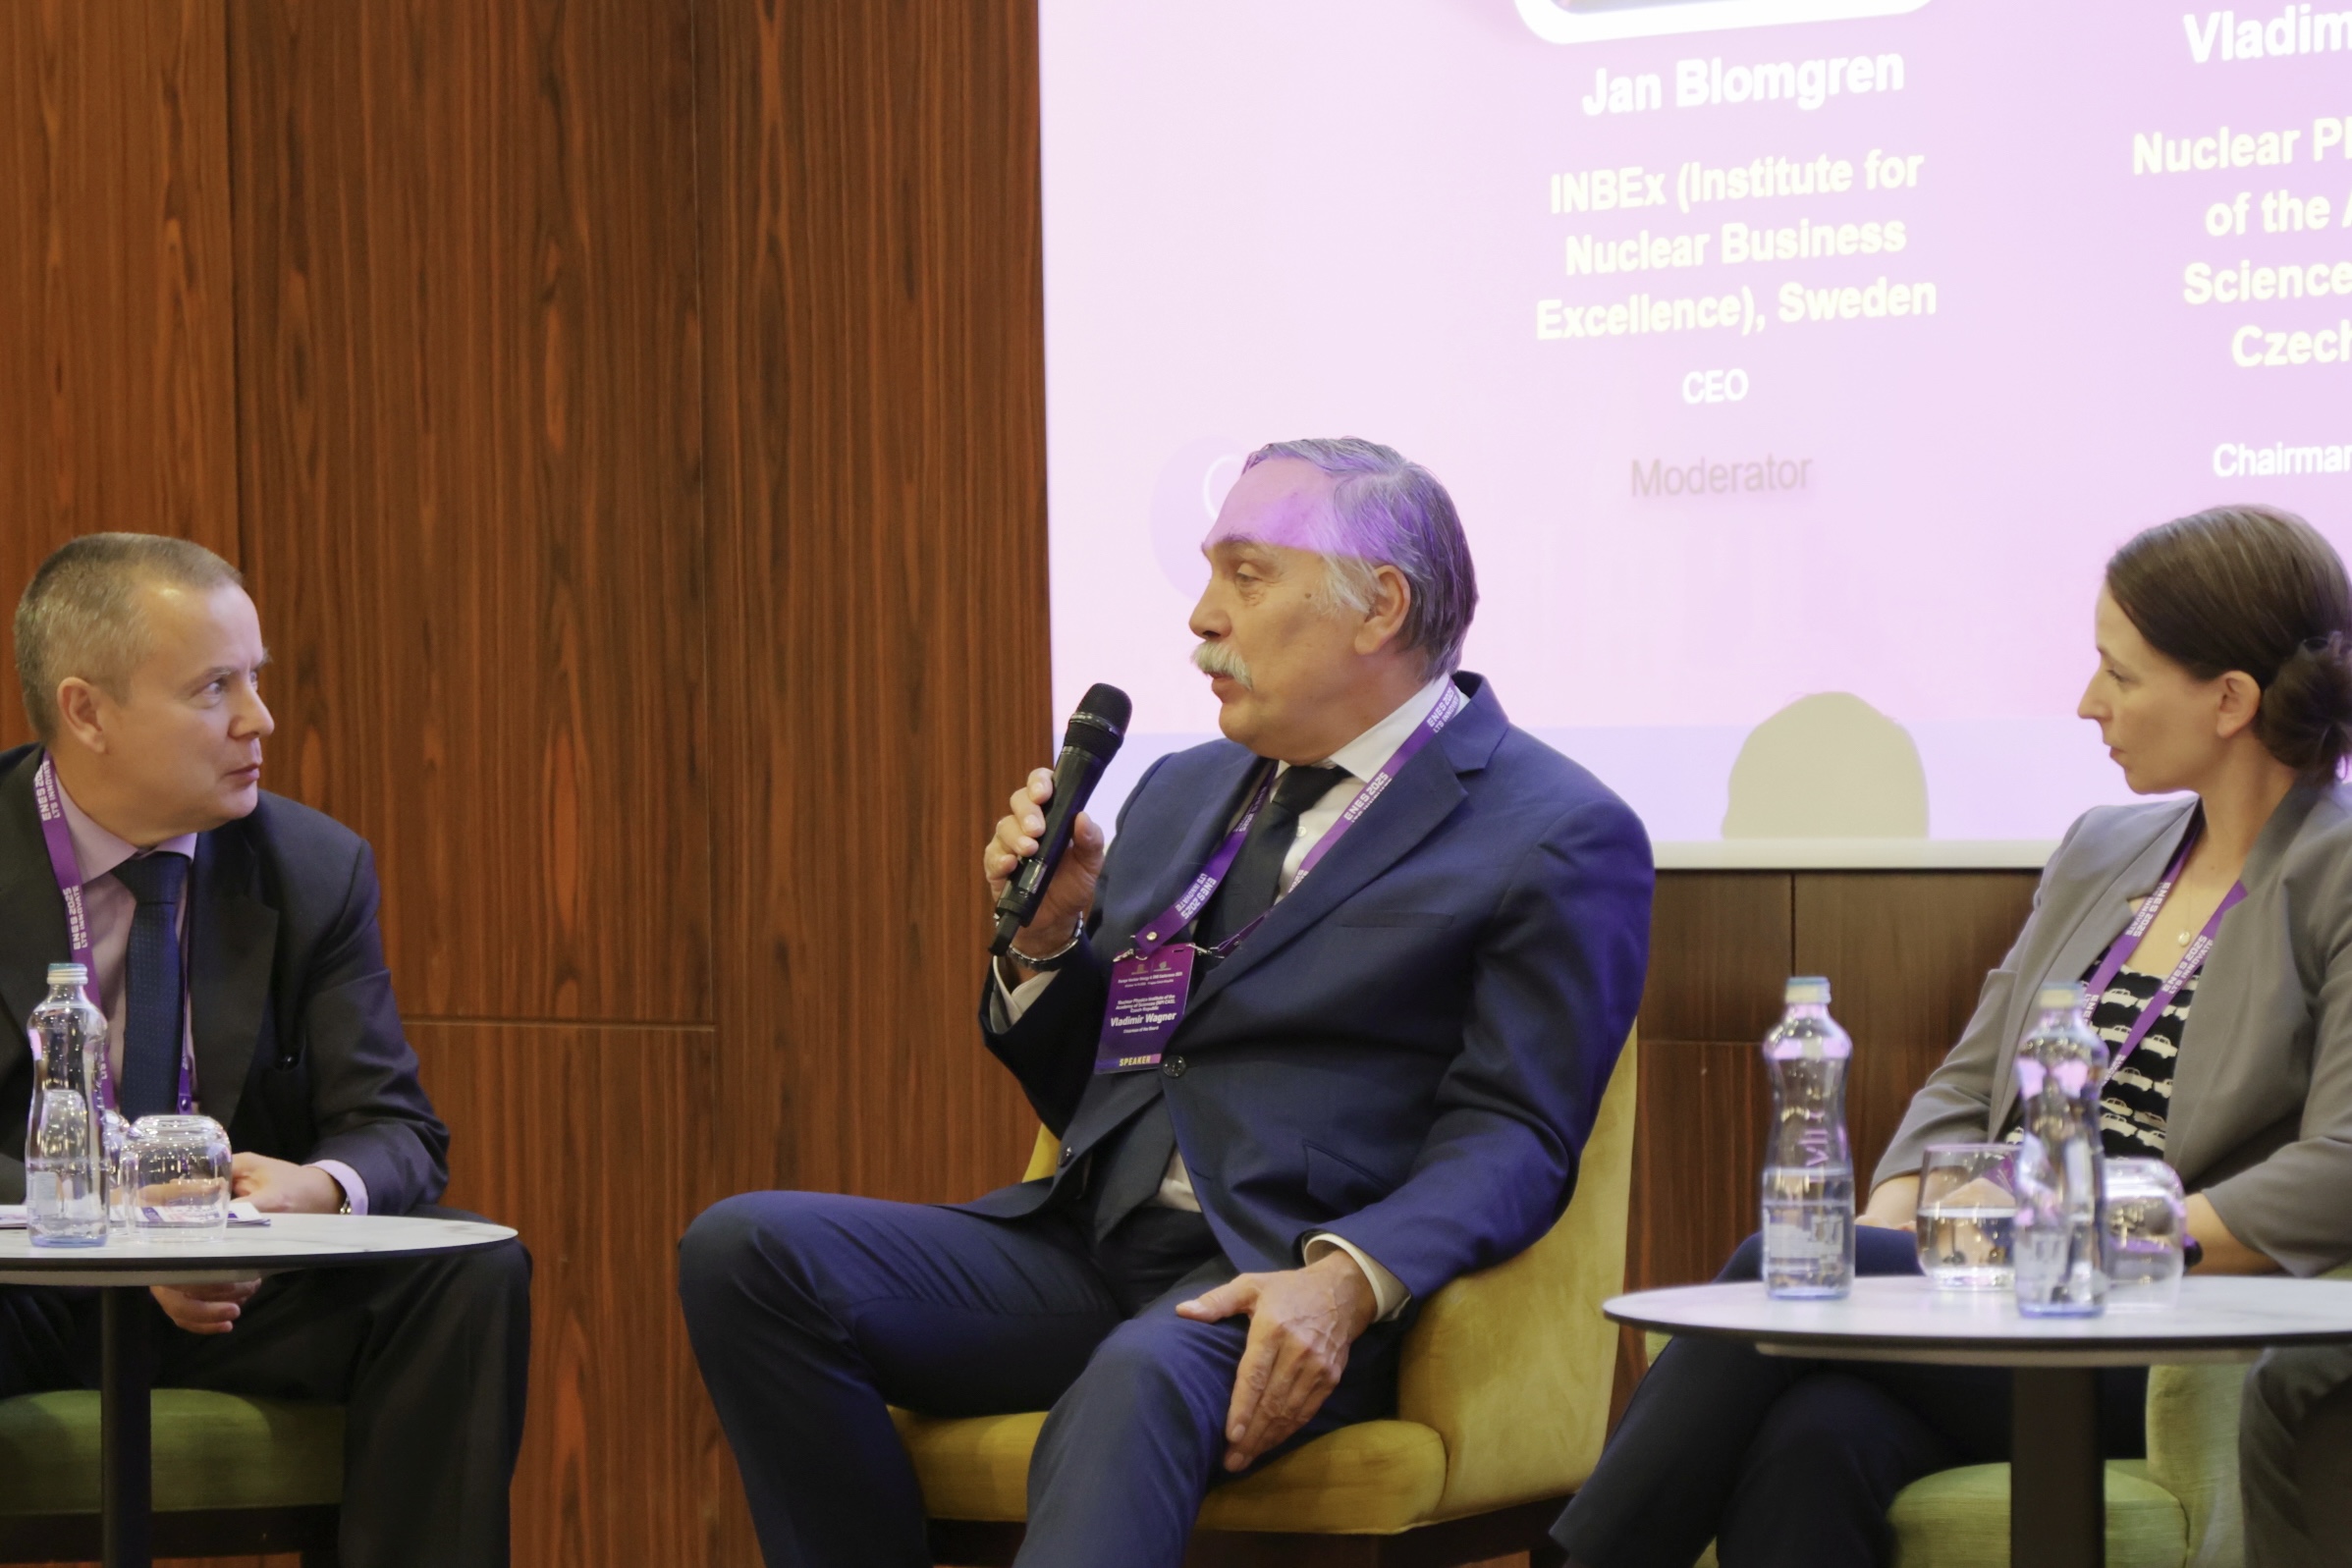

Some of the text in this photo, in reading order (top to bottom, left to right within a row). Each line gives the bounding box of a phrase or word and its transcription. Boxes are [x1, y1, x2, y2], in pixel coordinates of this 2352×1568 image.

[1582, 53, 1904, 116] Jan Blomgren
[2134, 126, 2301, 176] Nuclear
[1550, 148, 1924, 214] INBEx (Institute for
[2205, 191, 2251, 237] of
[2261, 189, 2330, 234] the
[1565, 218, 1907, 276] Nuclear Business
[2184, 259, 2352, 304] Science
[1536, 276, 1937, 340] Excellence), Sweden
[1682, 368, 1749, 405] CEO
[1631, 453, 1814, 497] Moderator
[1427, 687, 1454, 728] ENES 2025
[36, 787, 52, 822] ENES
[50, 802, 61, 819] LTS
[1343, 793, 1370, 821] ENES
[1366, 772, 1389, 796] 2025
[63, 887, 82, 950] ENES 2025
[72, 885, 85, 931] INNOVATE
[1180, 877, 1217, 920] ENES 2025
[2132, 882, 2171, 938] ENES 2025
[2161, 935, 2208, 992] ENES 2025
[2168, 980, 2183, 995] LTS
[1111, 1012, 1177, 1027] Vladimir Wagner
[1119, 1055, 1151, 1067] SPEAKER
